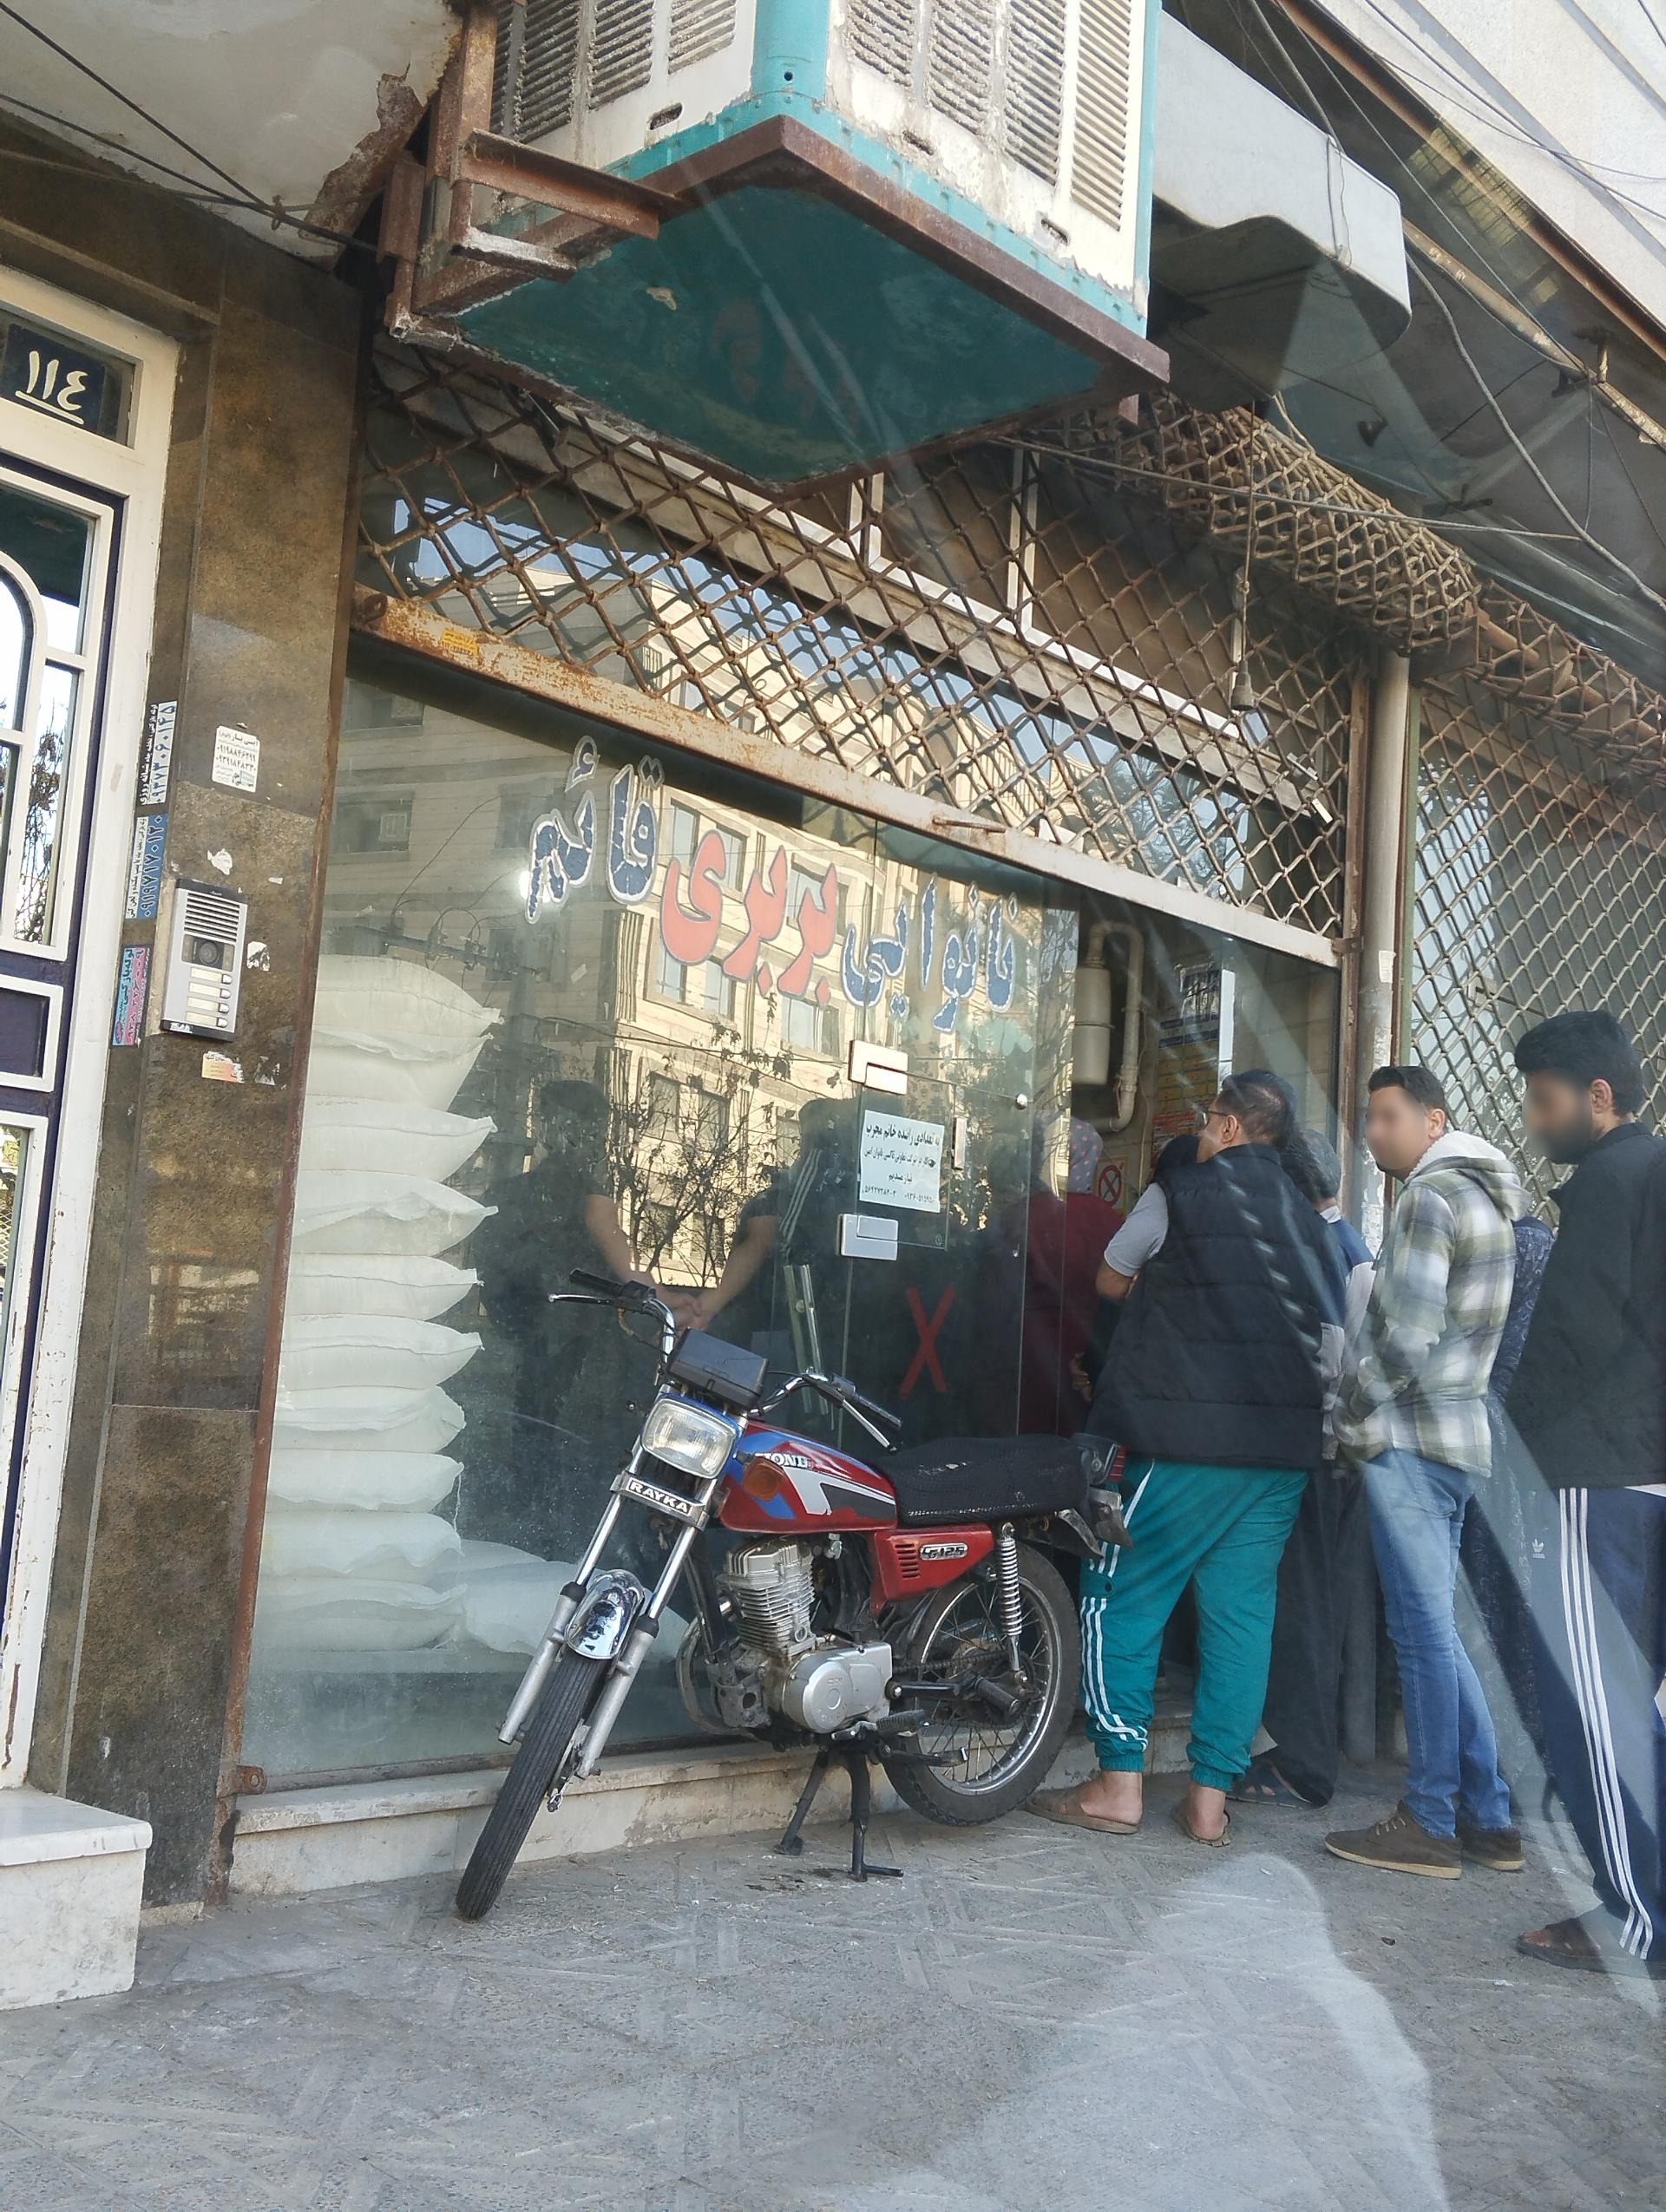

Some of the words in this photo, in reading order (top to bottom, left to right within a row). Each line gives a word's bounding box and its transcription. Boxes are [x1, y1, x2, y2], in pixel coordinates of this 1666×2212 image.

[140, 763, 151, 782] شبانه
[139, 783, 150, 805] روزی
[525, 736, 665, 924] قائم
[660, 829, 839, 1008] بربری
[883, 1123, 896, 1142] خانم
[898, 1128, 914, 1146] راننده
[629, 1480, 689, 1514] RAYKA
